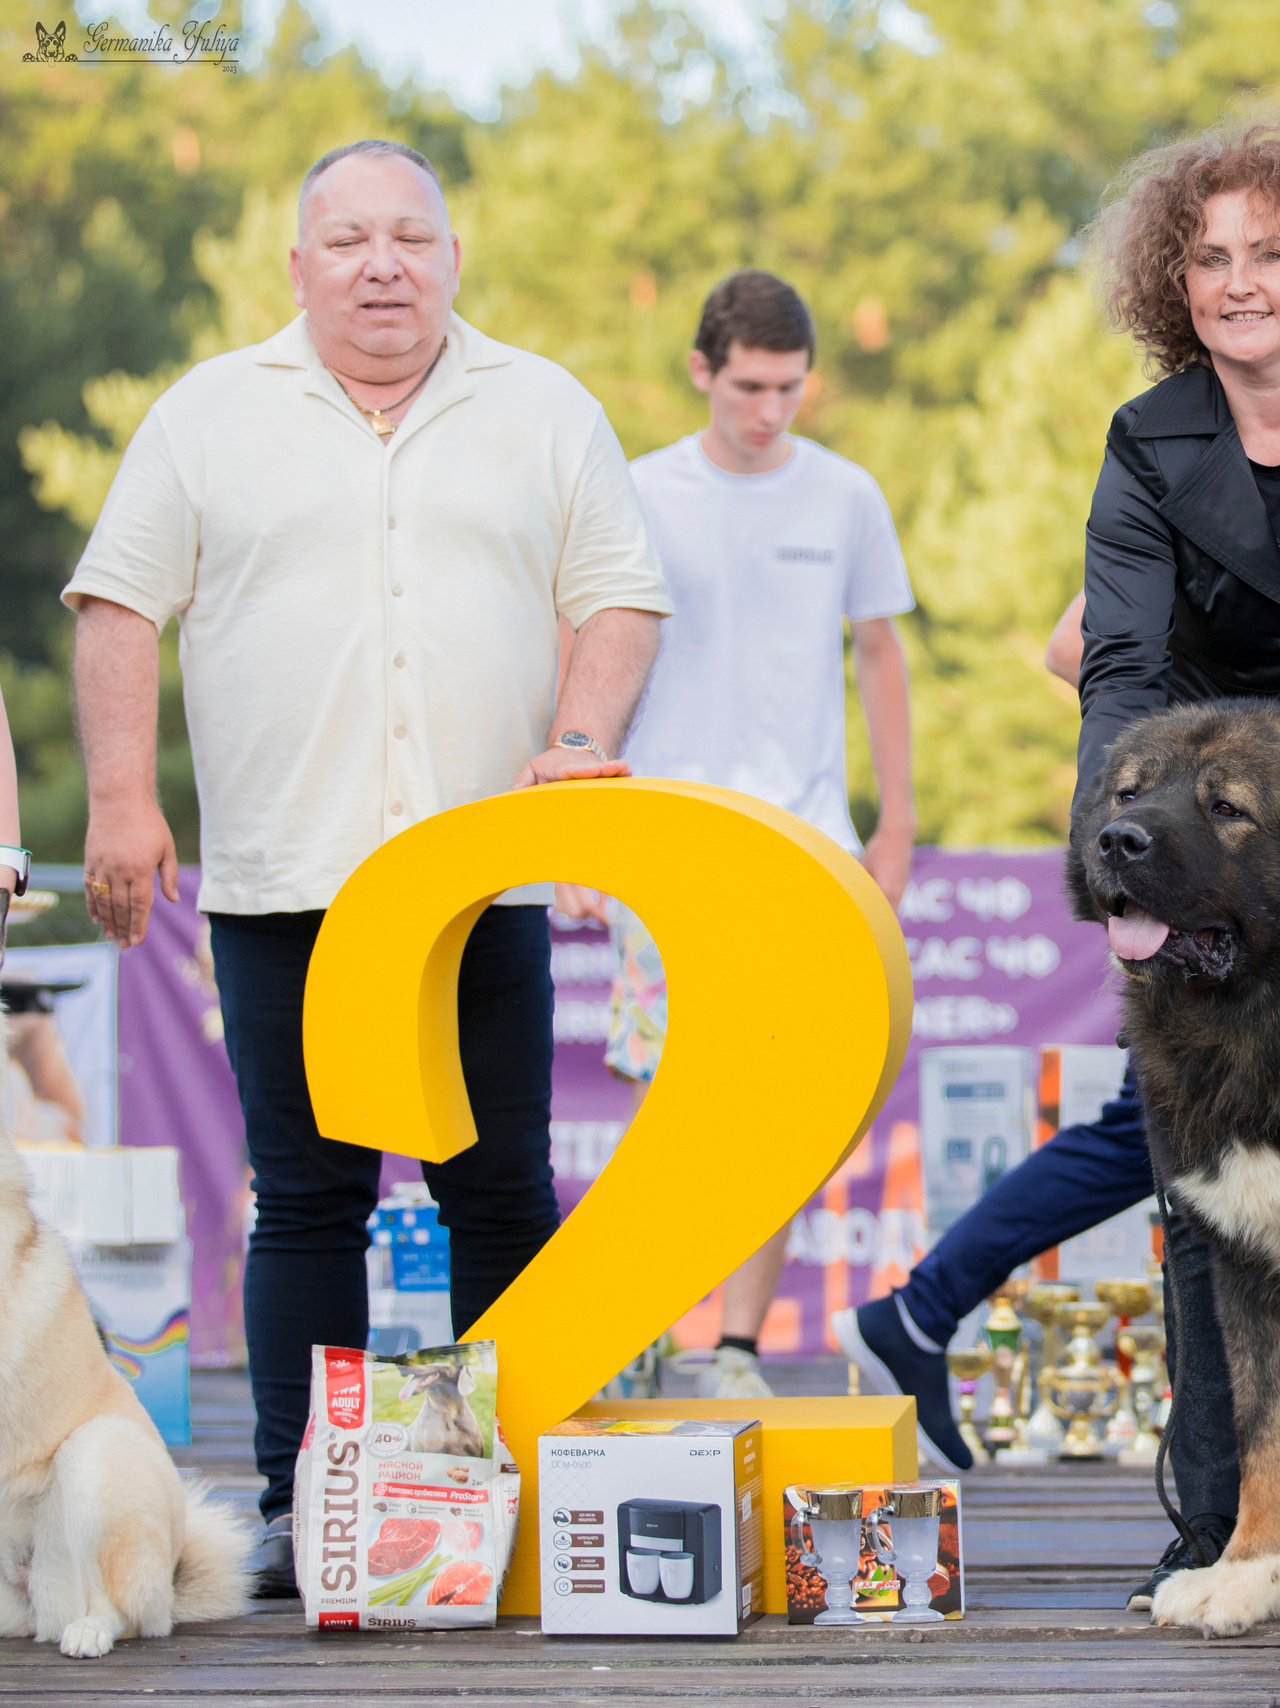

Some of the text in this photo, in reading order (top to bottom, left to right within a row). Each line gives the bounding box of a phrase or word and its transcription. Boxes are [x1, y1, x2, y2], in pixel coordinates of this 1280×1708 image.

[331, 1397, 360, 1409] ADULT
[375, 1434, 402, 1443] 40%
[551, 1449, 606, 1457] КОФЕВАРКА
[379, 1461, 423, 1471] МЯСНОЙ
[551, 1461, 592, 1469] DCM-0500
[378, 1471, 421, 1481] РАЦИОН
[450, 1491, 485, 1502] ProStor+
[320, 1440, 360, 1592] SIRIUS
[368, 1617, 416, 1627] SIRIUS
